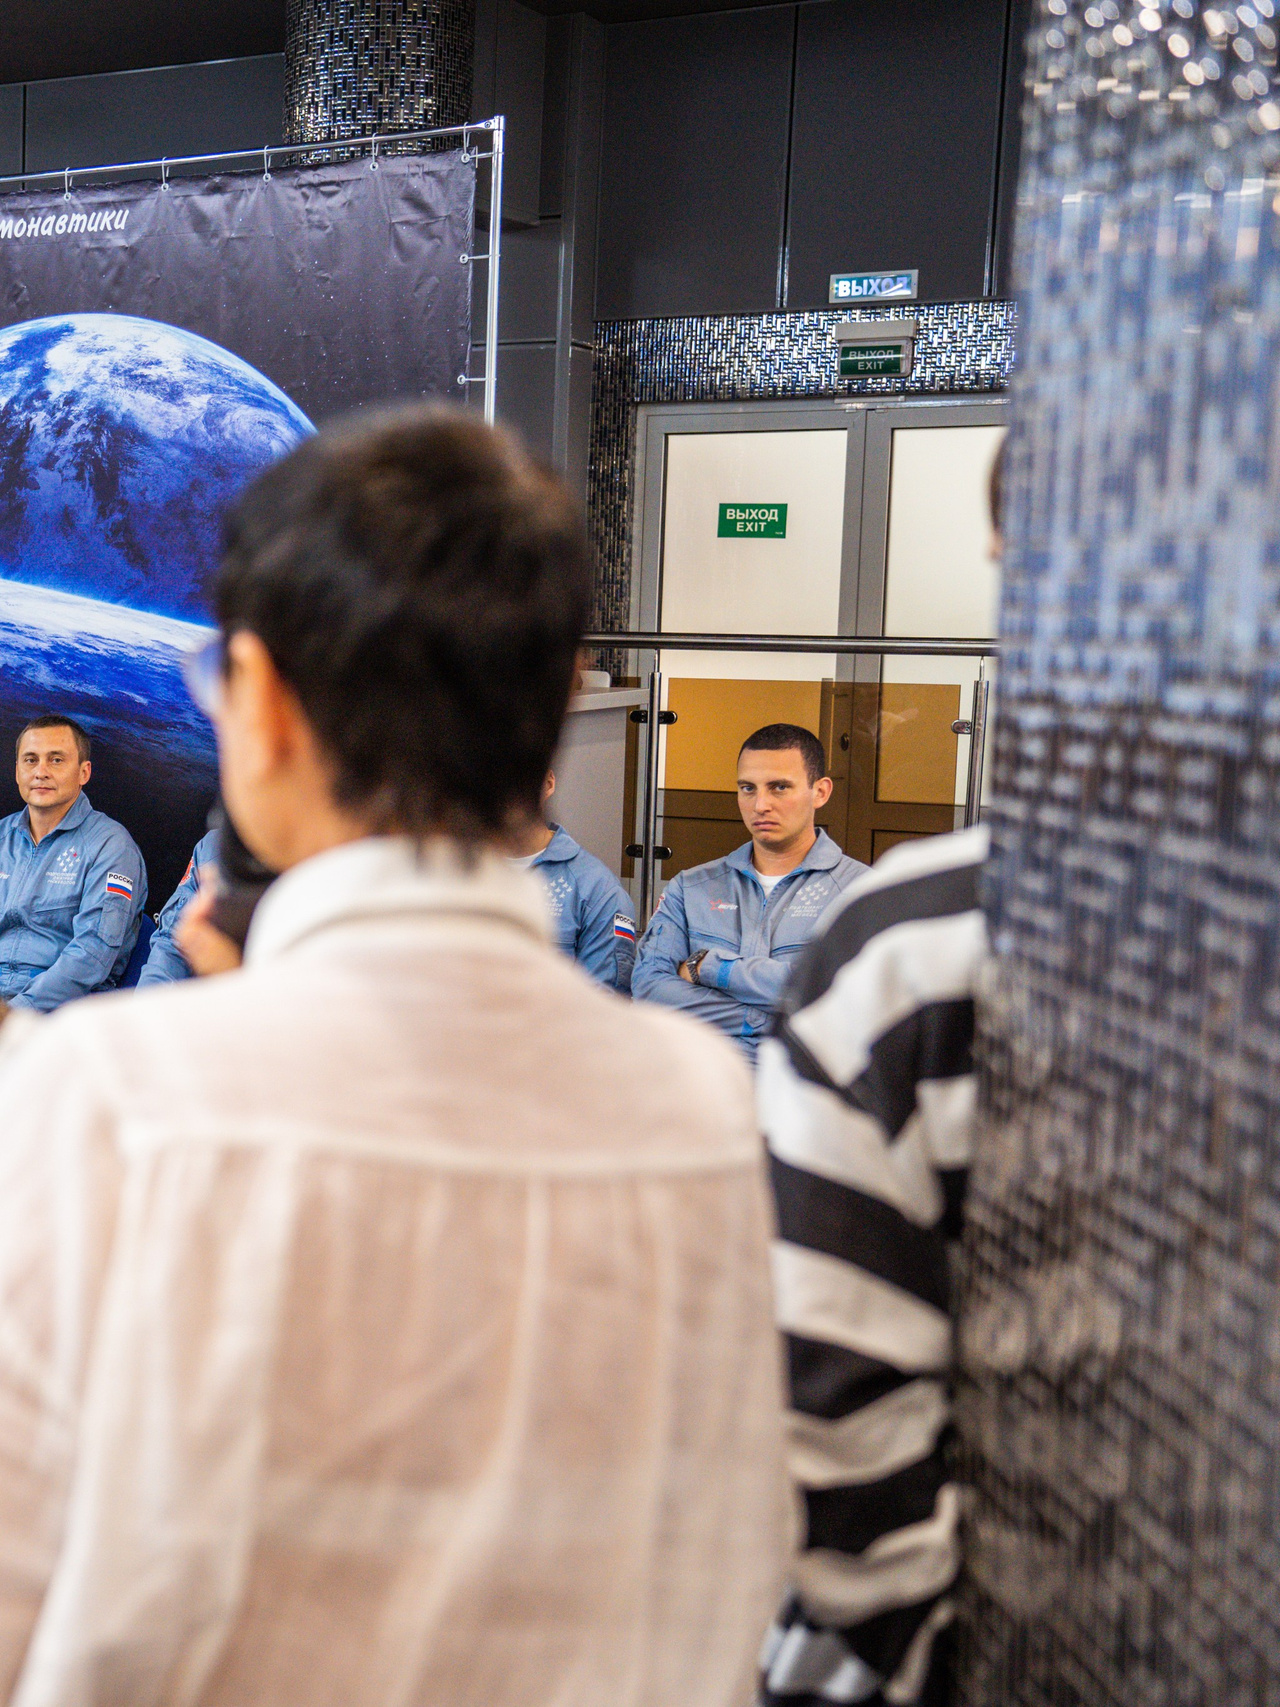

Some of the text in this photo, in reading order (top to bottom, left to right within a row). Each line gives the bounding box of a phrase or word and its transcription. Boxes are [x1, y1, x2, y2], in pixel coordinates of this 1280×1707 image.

[838, 277, 910, 297] ВЫХОД
[849, 349, 894, 361] ВЫХОД
[858, 361, 884, 370] EXIT
[726, 509, 778, 522] ВЫХОД
[736, 522, 767, 532] EXIT
